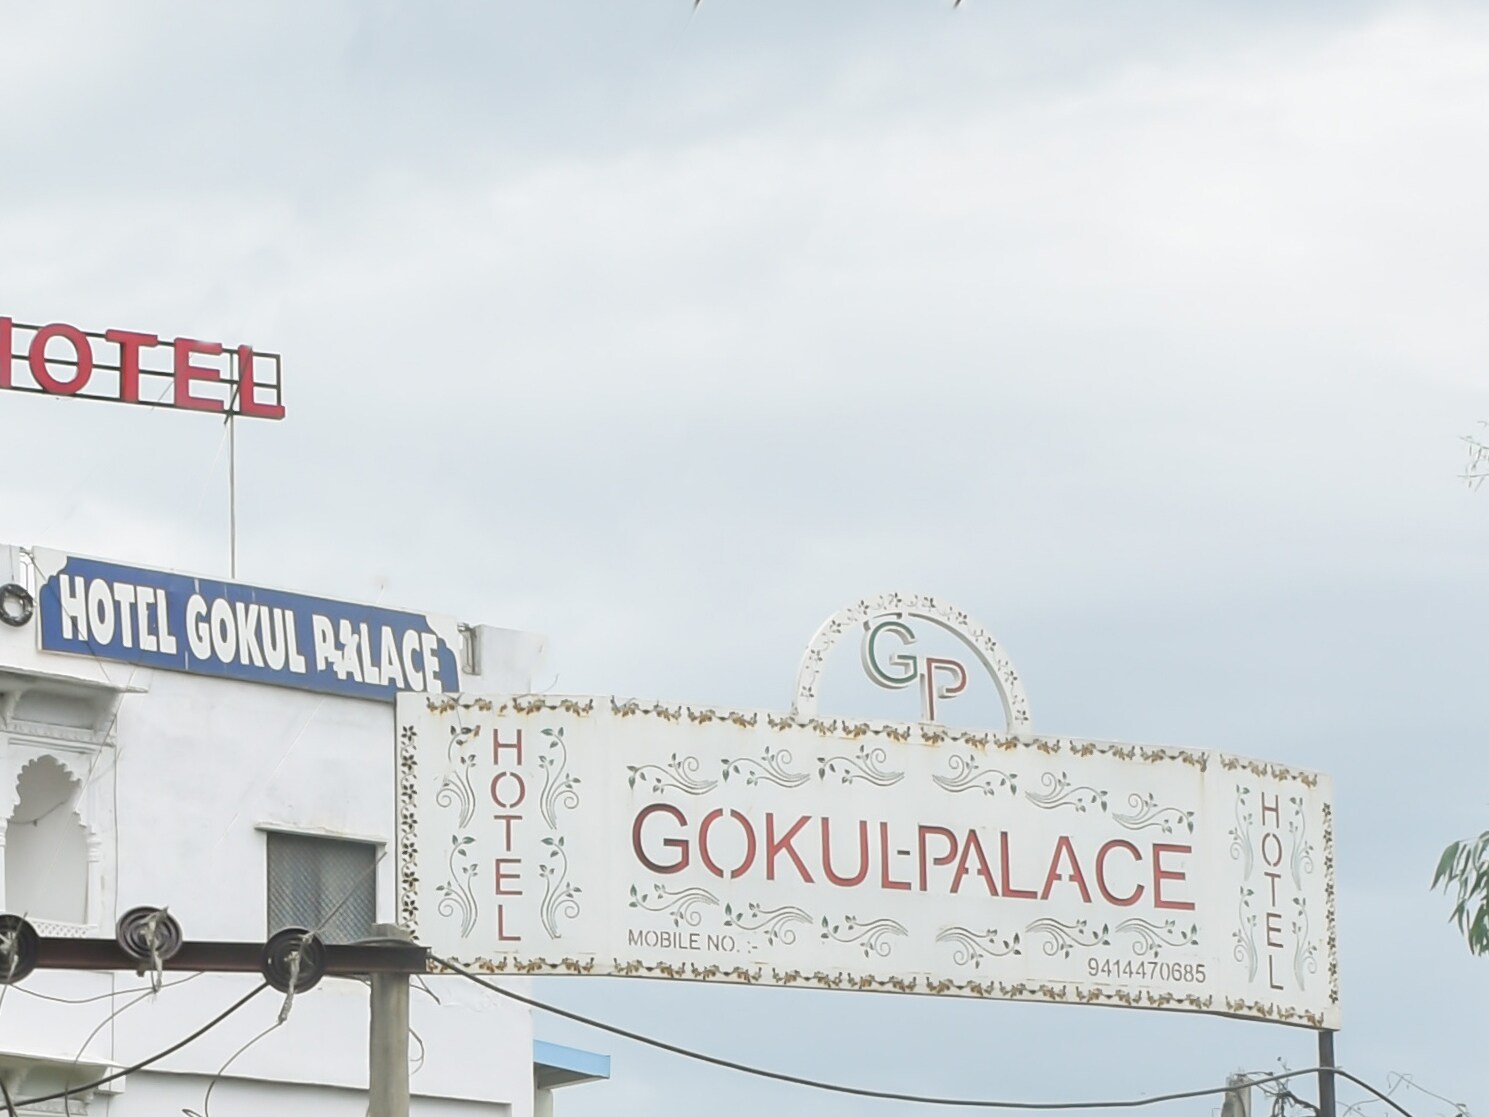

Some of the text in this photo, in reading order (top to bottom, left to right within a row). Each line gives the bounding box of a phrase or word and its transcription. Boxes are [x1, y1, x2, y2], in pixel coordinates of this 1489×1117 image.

[59, 574, 443, 694] HOTEL GOKUL PALACE
[490, 728, 526, 941] HOTEL
[1261, 791, 1284, 990] HOTEL
[628, 929, 701, 950] MOBILE
[1088, 957, 1206, 983] 9414470685
